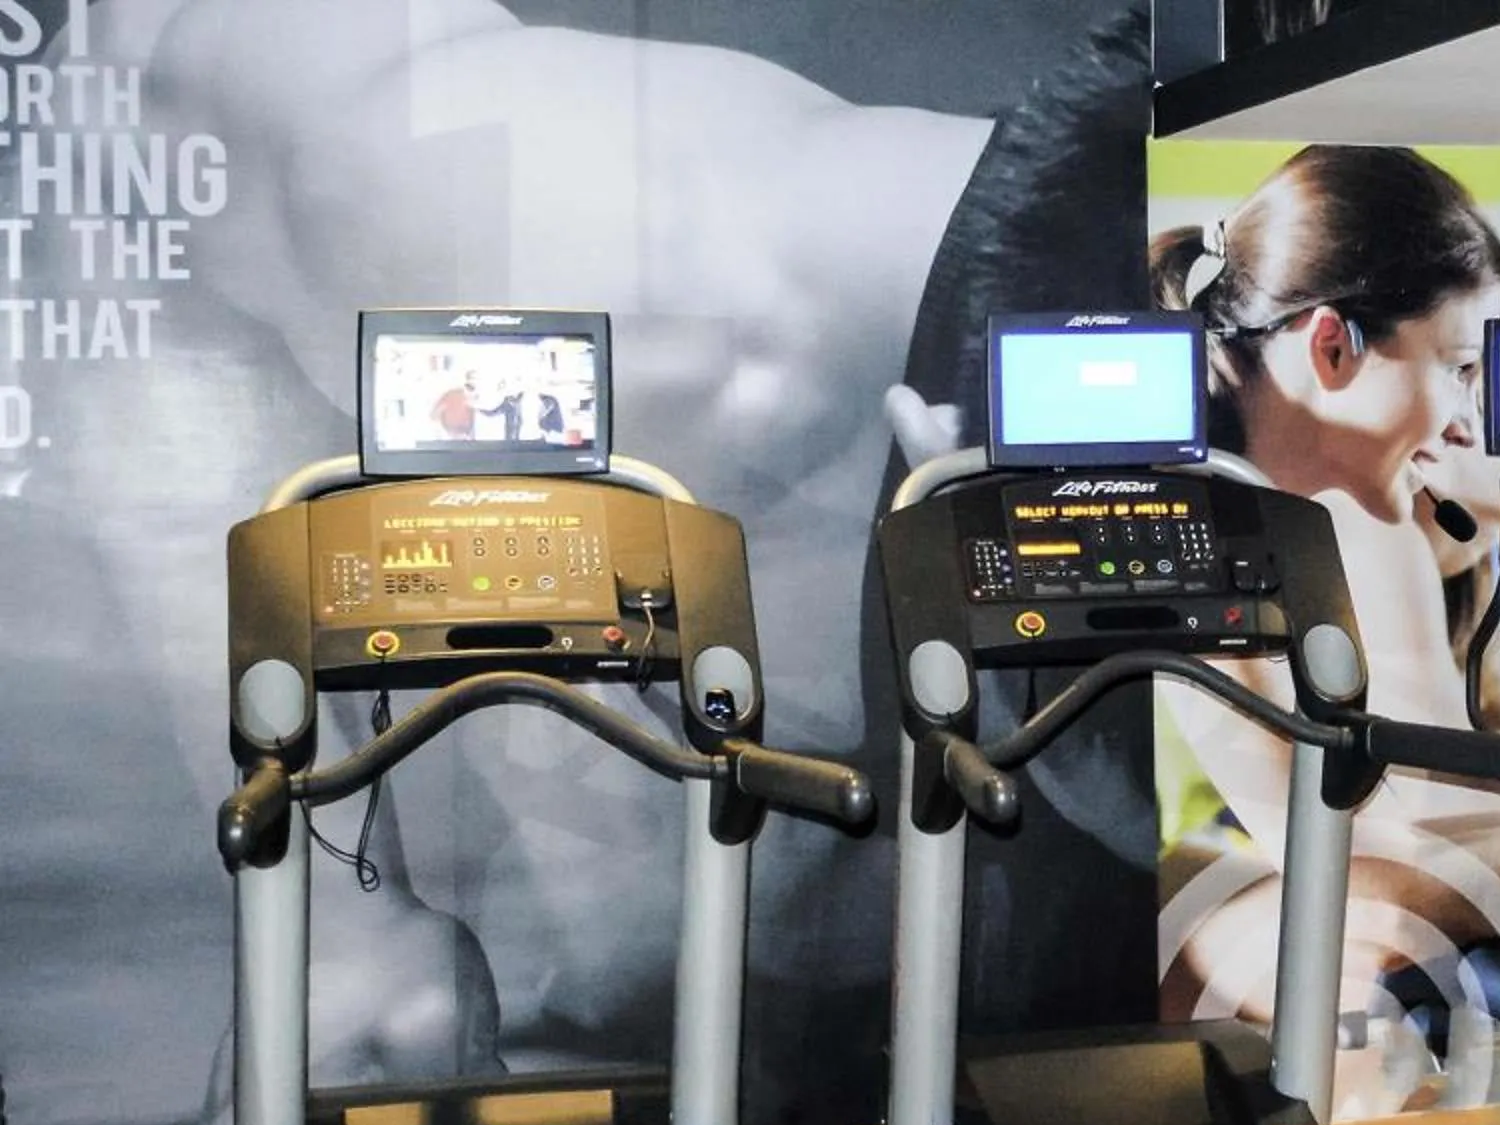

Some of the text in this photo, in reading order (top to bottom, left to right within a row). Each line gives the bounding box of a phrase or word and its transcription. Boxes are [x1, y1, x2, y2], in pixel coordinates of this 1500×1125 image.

[0, 64, 140, 126] RTH
[0, 131, 227, 217] HING
[69, 219, 190, 280] THE
[0, 298, 161, 359] THAT
[1052, 481, 1160, 496] Life Fitness
